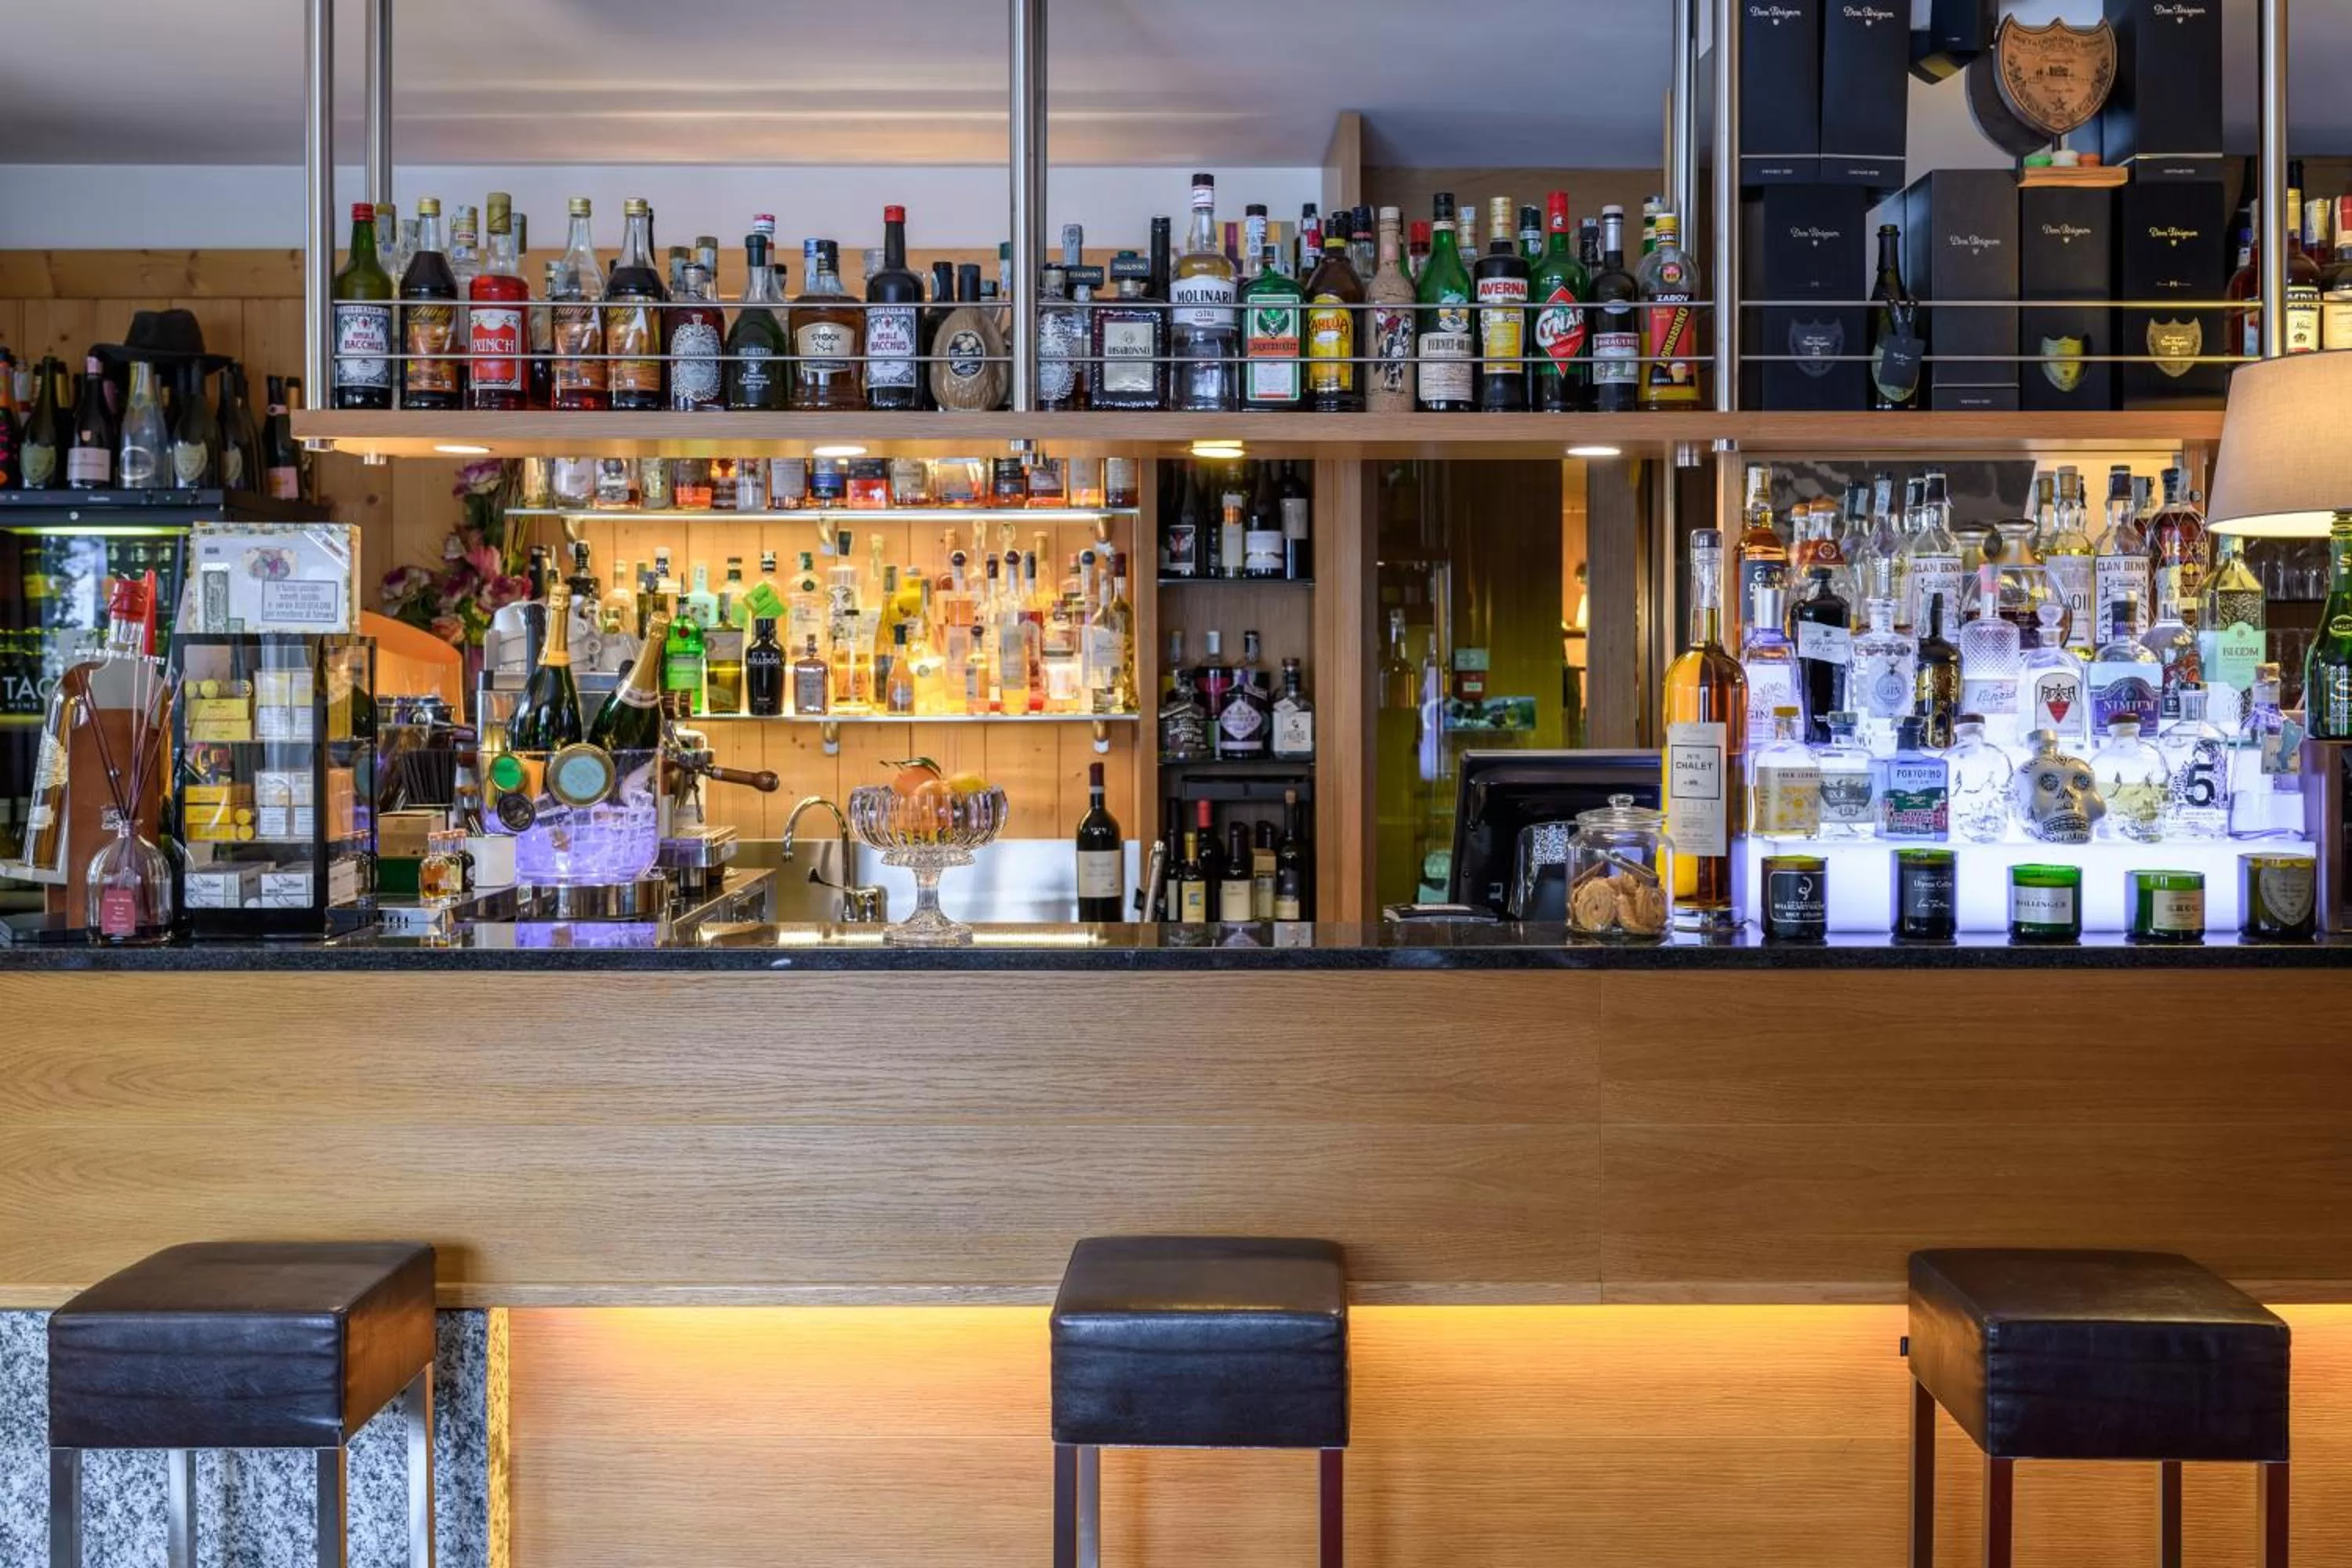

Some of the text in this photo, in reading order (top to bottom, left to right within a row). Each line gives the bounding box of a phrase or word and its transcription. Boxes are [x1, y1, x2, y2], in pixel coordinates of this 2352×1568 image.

[1479, 281, 1526, 296] AVERNA
[1177, 289, 1232, 304] MOLINARI
[1656, 294, 1689, 303] ZABOV
[1535, 304, 1584, 348] CYNAR
[871, 340, 906, 351] BACCHUS
[2098, 561, 2121, 572] CLAN
[2223, 647, 2259, 657] BLOOM
[1675, 761, 1713, 771] CHALET
[1896, 769, 1942, 779] PORTOFINO
[2184, 764, 2215, 807] 5
